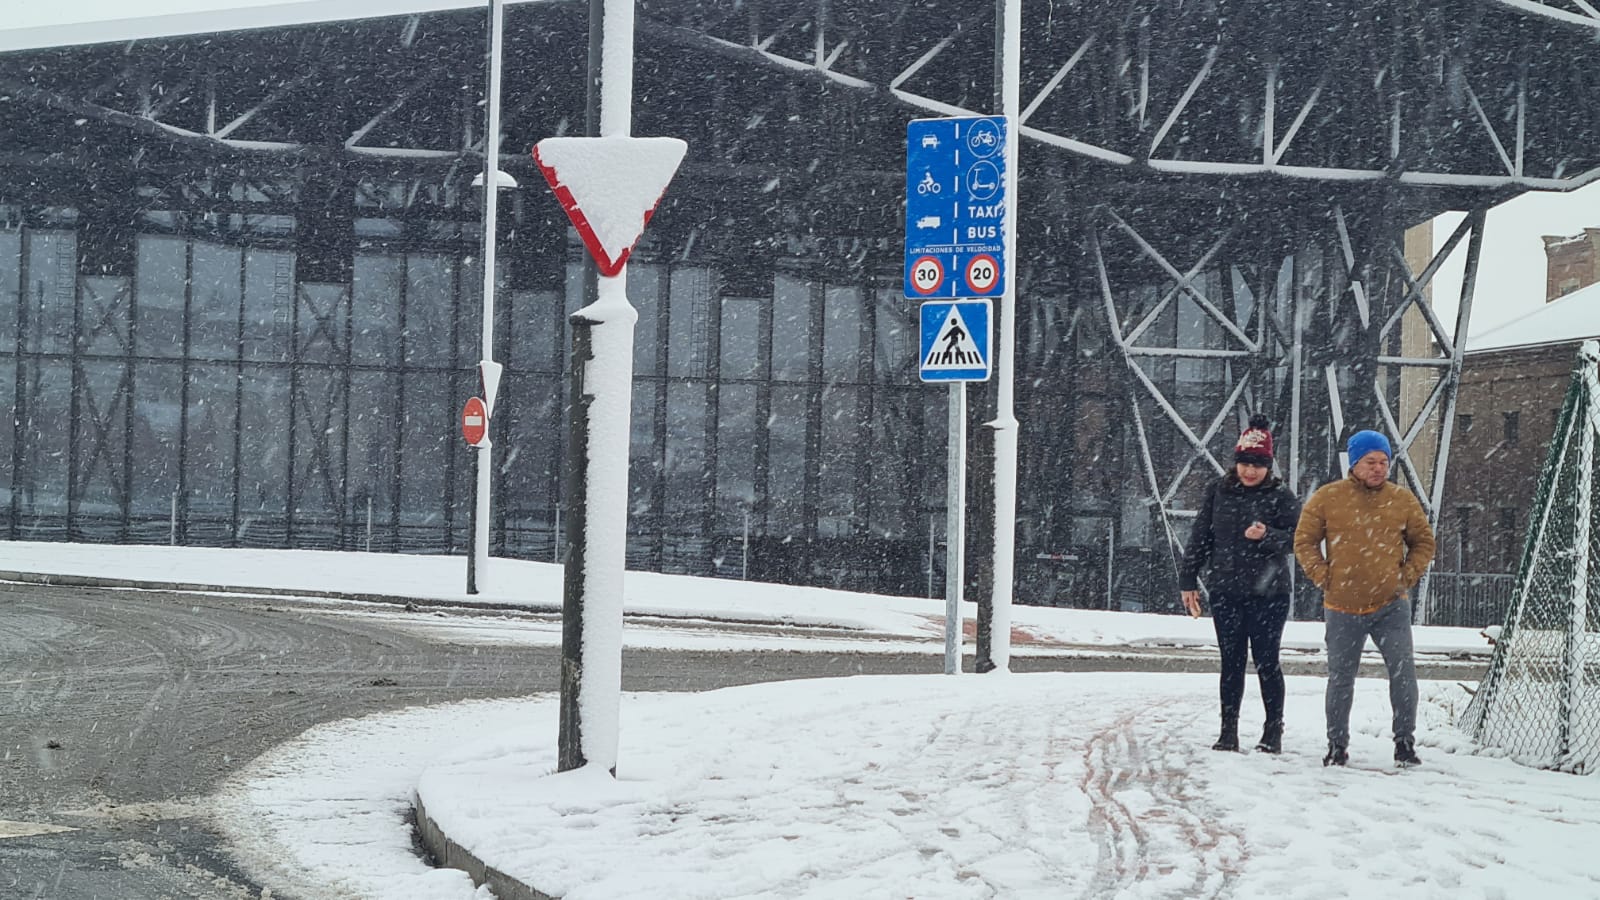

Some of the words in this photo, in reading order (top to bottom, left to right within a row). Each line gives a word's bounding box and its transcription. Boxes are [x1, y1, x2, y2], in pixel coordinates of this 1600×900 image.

[968, 205, 998, 218] TAXI
[968, 226, 996, 239] BUS
[910, 246, 953, 254] LIMITACIONES
[918, 268, 937, 281] 30
[973, 267, 992, 280] 20
